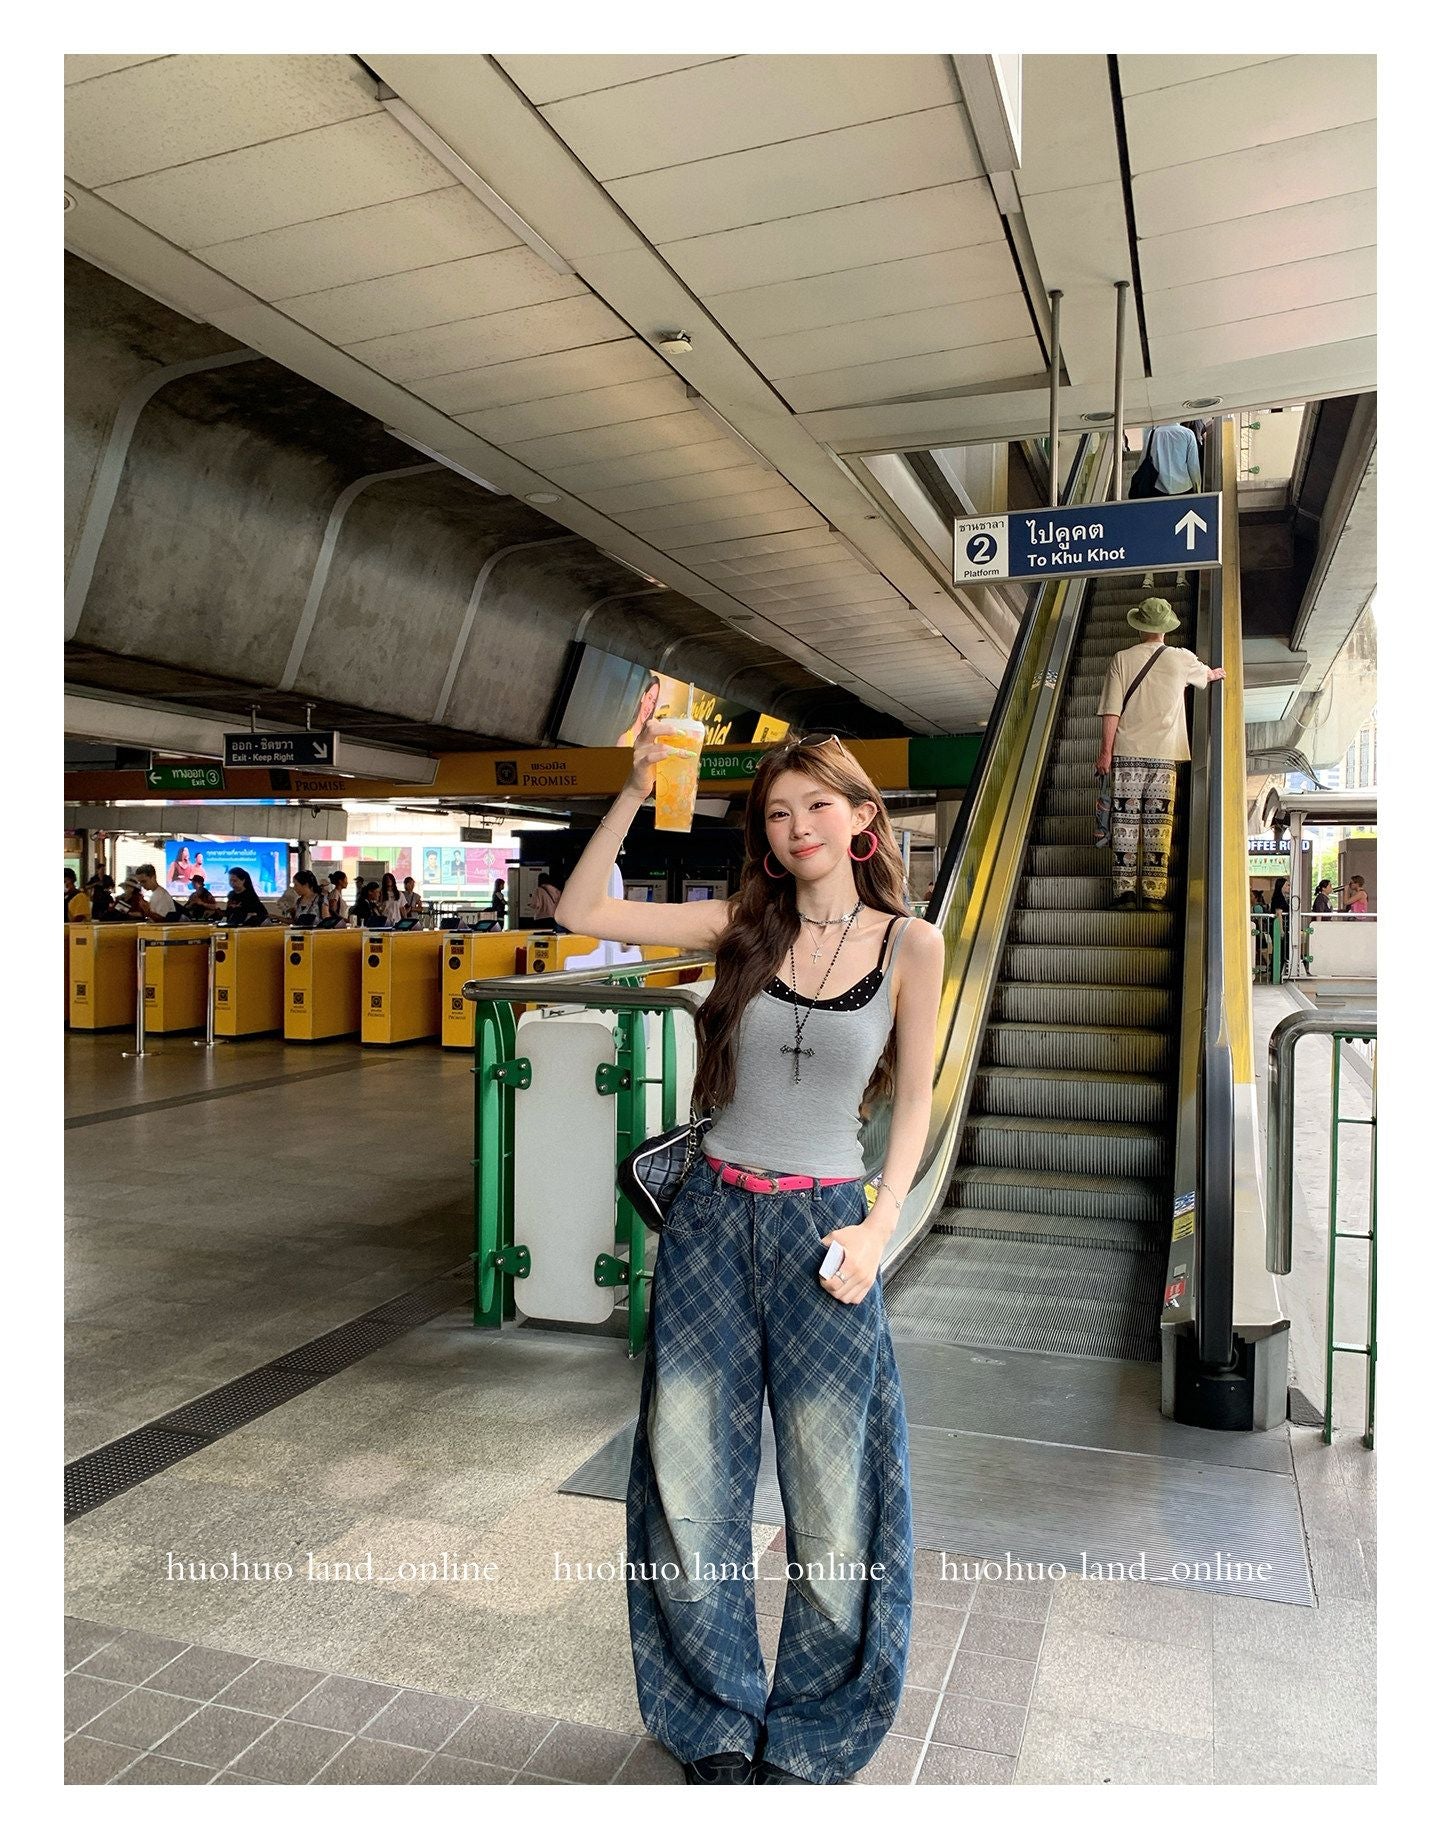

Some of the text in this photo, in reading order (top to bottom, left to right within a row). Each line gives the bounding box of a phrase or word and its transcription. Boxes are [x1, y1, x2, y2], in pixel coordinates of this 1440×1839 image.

[959, 520, 1005, 532] ชานชาลา
[1026, 519, 1104, 550] ไปคูคต
[1027, 548, 1126, 568] To Khu Khot
[963, 568, 1000, 578] Platform
[232, 741, 252, 750] ออก
[232, 753, 247, 762] Exit
[253, 753, 272, 763] Keep
[273, 753, 294, 763] Right
[710, 768, 726, 776] Exit
[523, 774, 578, 787] PROMISE
[295, 781, 346, 792] PROMISE
[1279, 840, 1310, 851] RD
